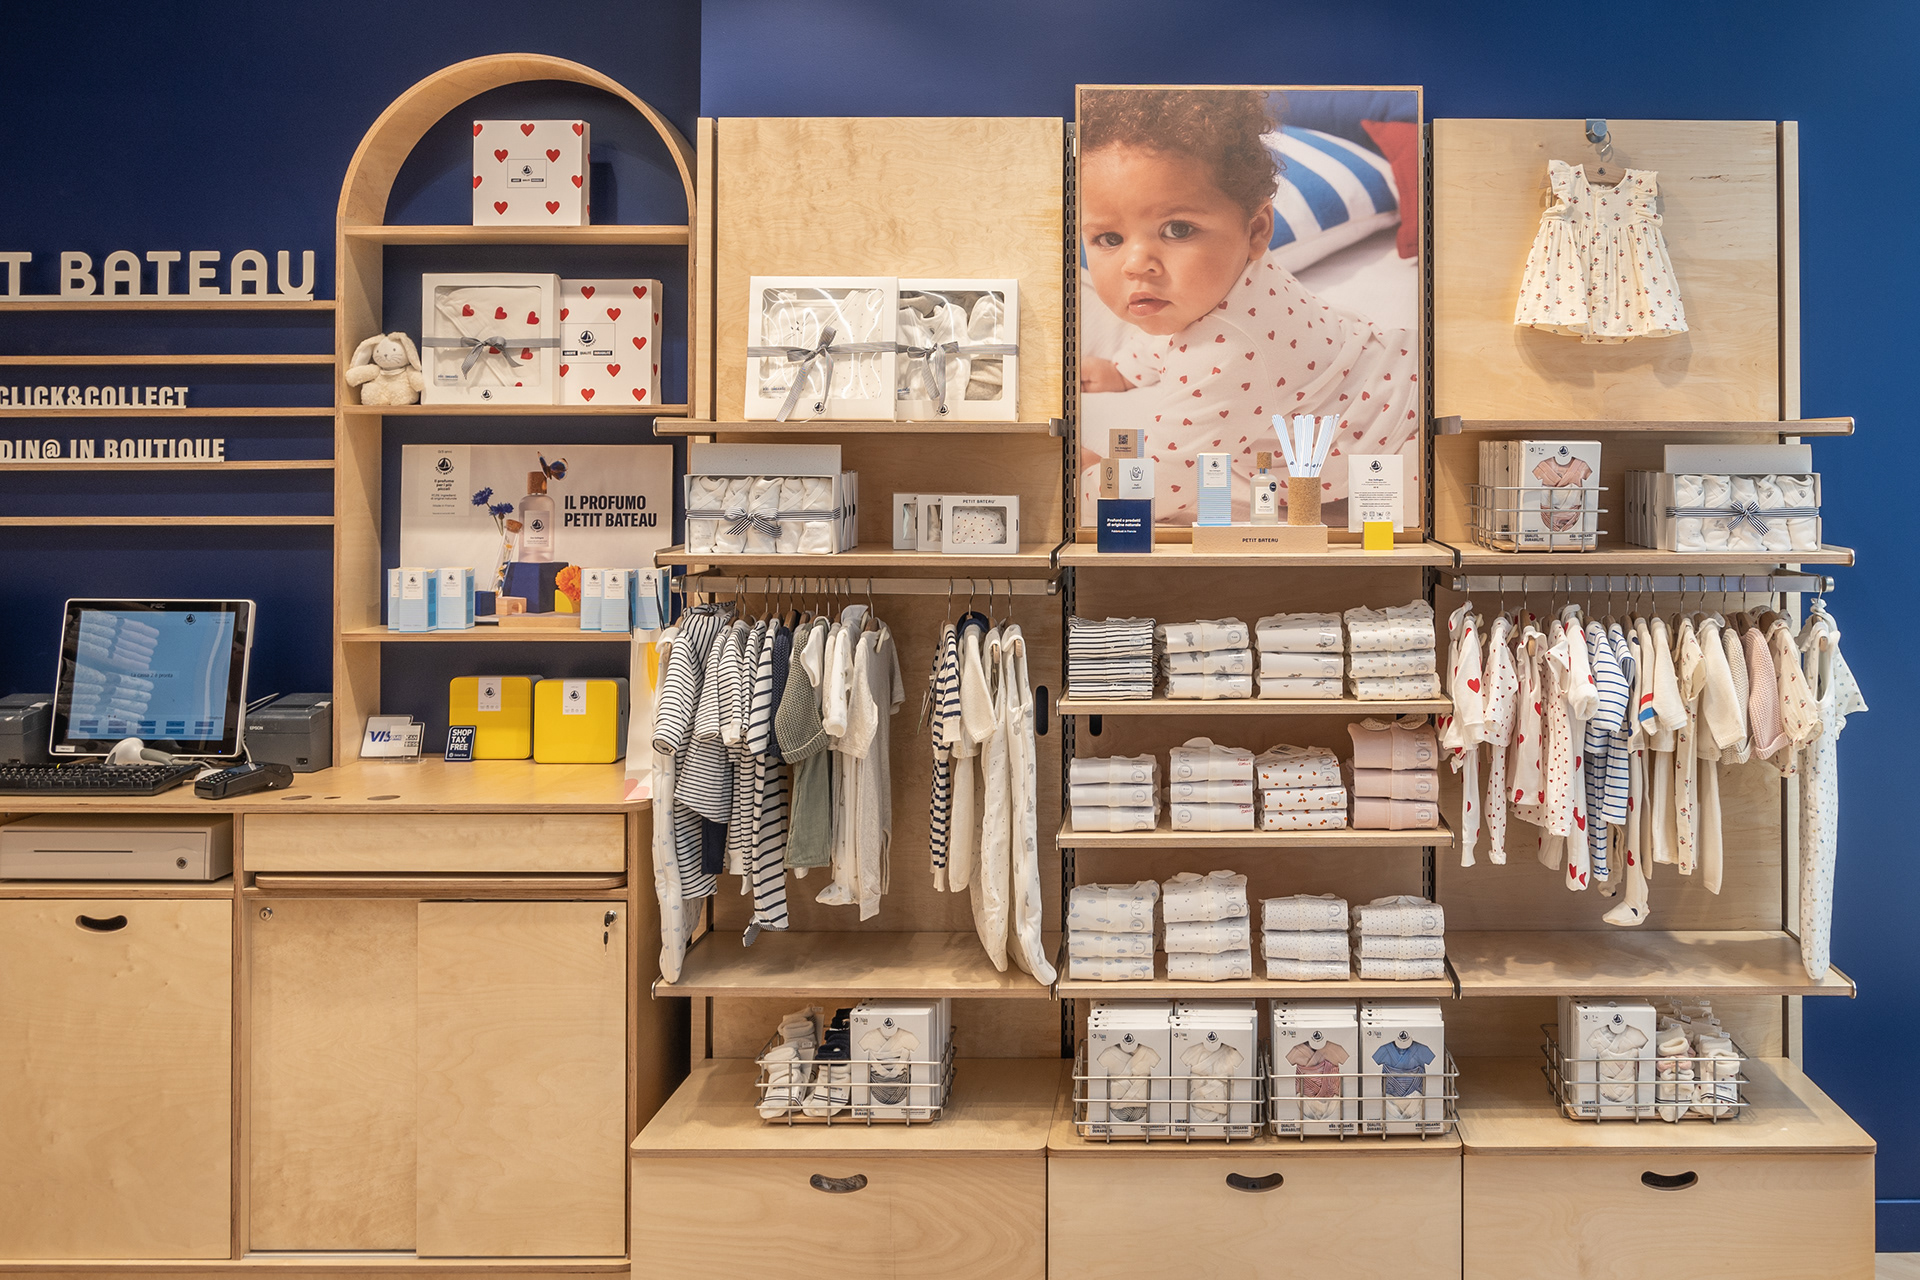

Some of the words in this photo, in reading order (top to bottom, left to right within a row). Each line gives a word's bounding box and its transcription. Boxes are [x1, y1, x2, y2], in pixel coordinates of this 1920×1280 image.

[60, 250, 314, 296] BATEAU
[0, 386, 188, 406] CLICK&COLLECT
[70, 439, 95, 458] IN
[104, 438, 224, 458] BOUTIQUE
[564, 495, 577, 510] IL
[580, 495, 646, 510] PROFUMO
[564, 512, 602, 527] PETIT
[605, 512, 657, 527] BATEAU
